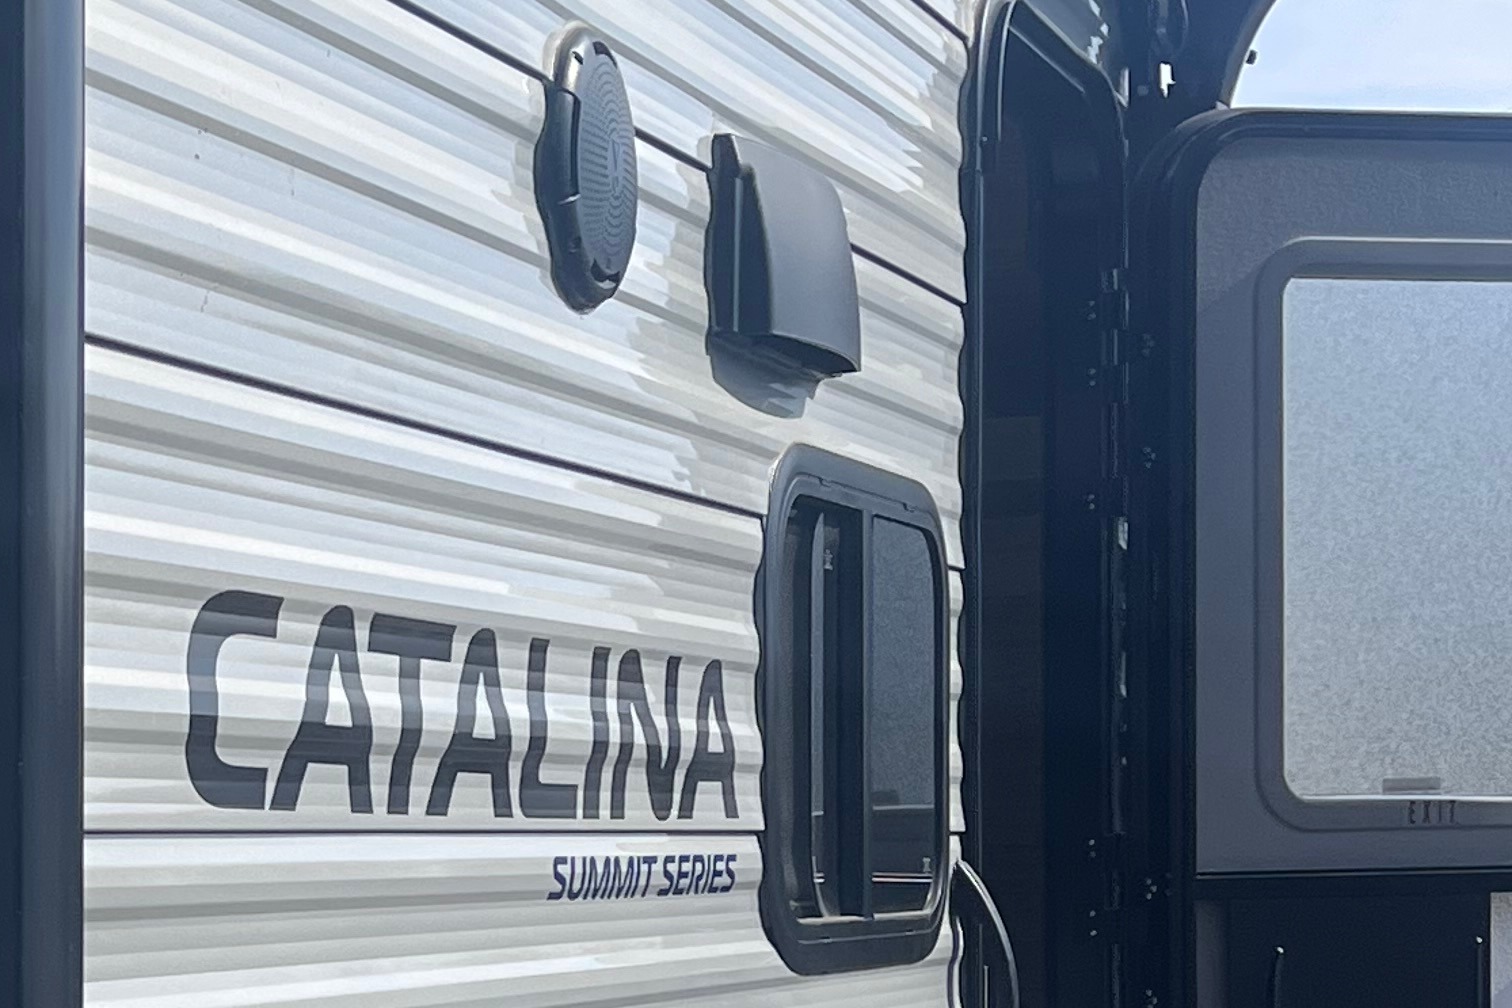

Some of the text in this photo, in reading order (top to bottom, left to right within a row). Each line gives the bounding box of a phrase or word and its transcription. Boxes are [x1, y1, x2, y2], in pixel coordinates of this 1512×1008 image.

[186, 589, 739, 821] CATALINA
[546, 854, 737, 901] SUMMIT SERIES
